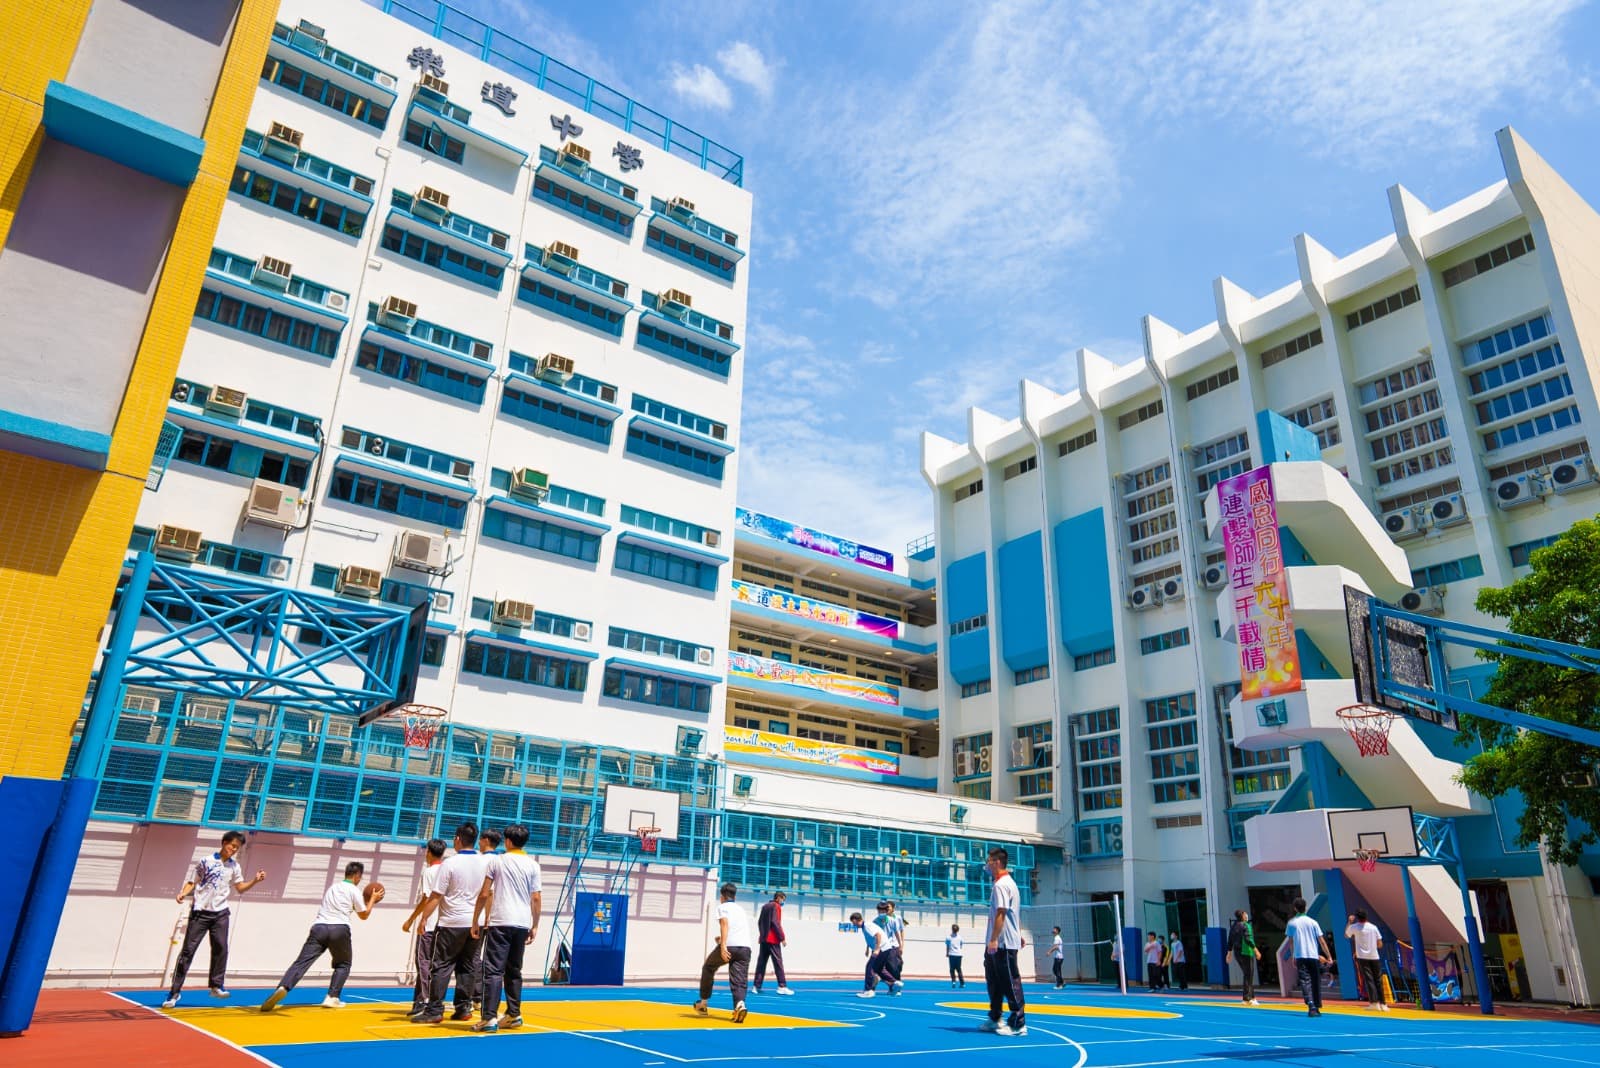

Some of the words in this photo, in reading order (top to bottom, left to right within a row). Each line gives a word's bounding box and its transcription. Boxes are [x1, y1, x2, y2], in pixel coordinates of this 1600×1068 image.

[1223, 493, 1266, 672] 連繫師生千載情
[1249, 479, 1290, 648] 感恩同行六十年
[743, 732, 759, 746] will
